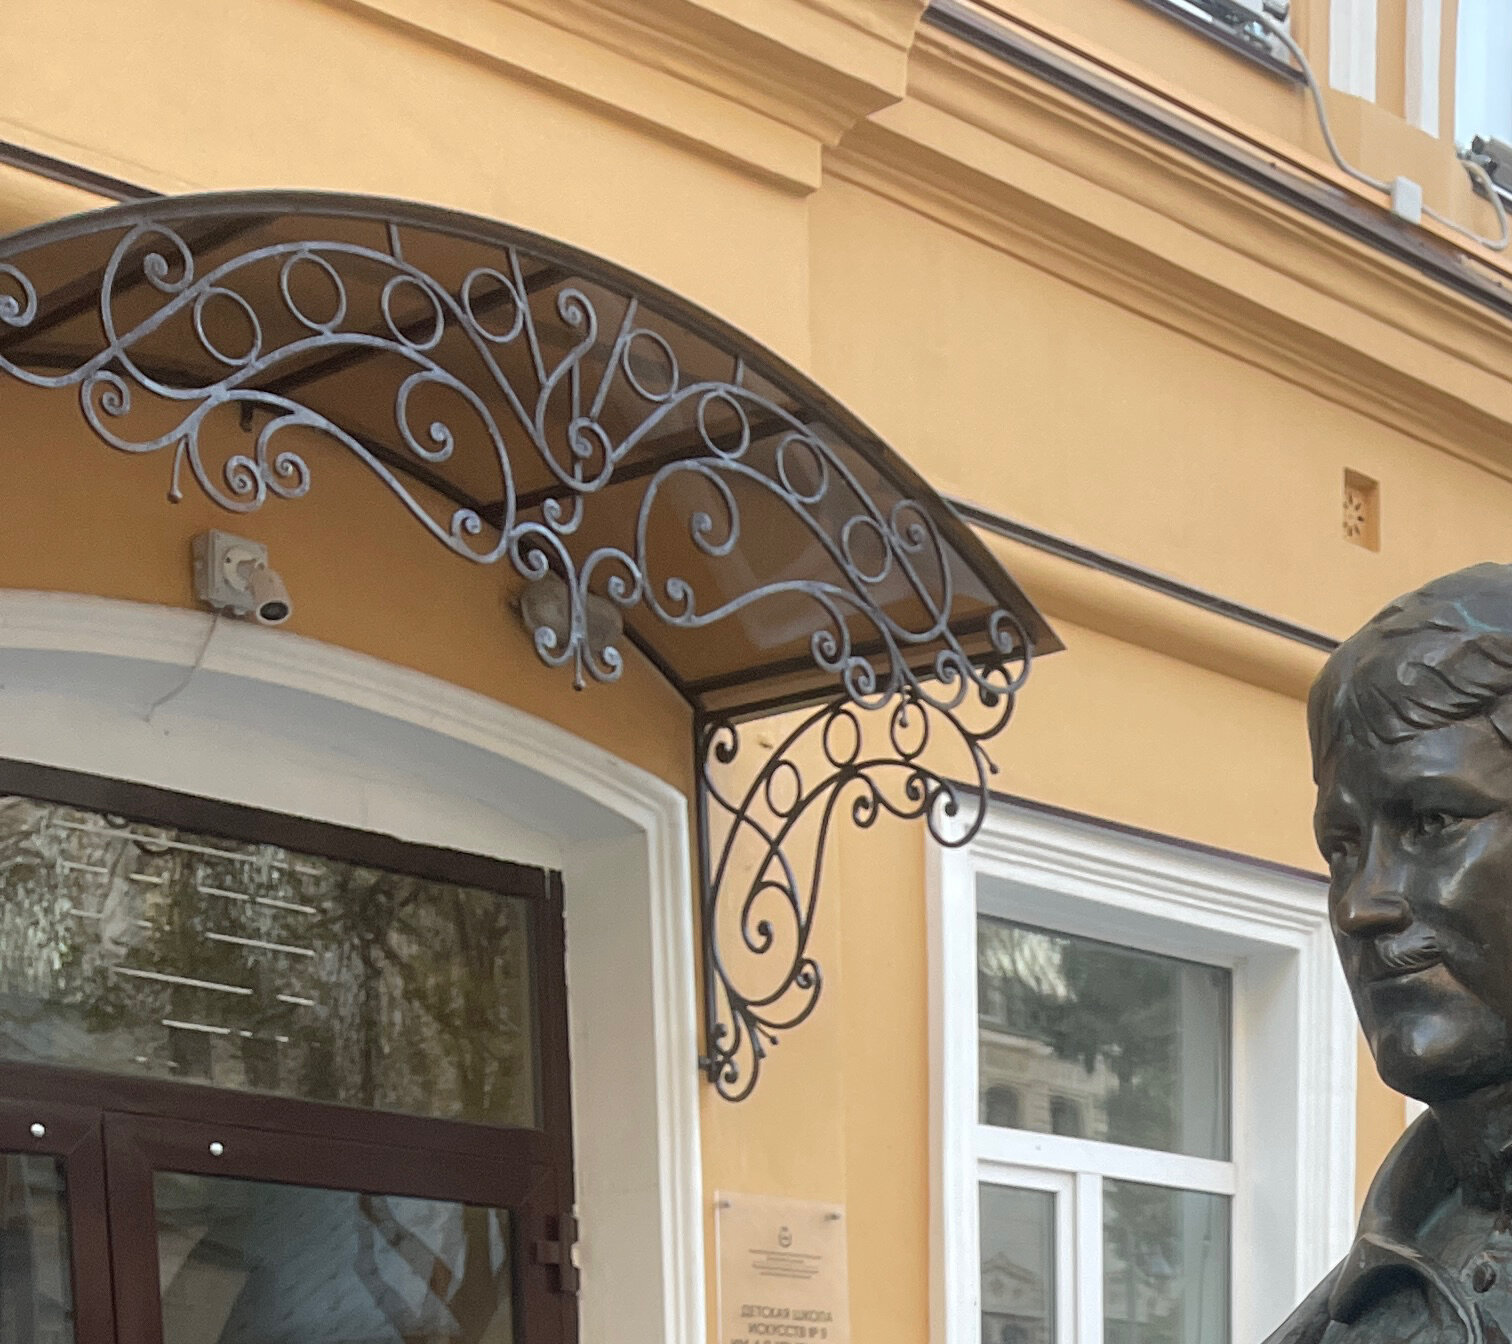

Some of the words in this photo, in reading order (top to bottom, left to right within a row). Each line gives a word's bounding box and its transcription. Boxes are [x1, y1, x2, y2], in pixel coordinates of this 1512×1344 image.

[741, 1304, 790, 1318] ДЕТСКАЯ
[791, 1309, 833, 1322] ШКОЛА
[748, 1322, 807, 1338] ИСКУССТВ
